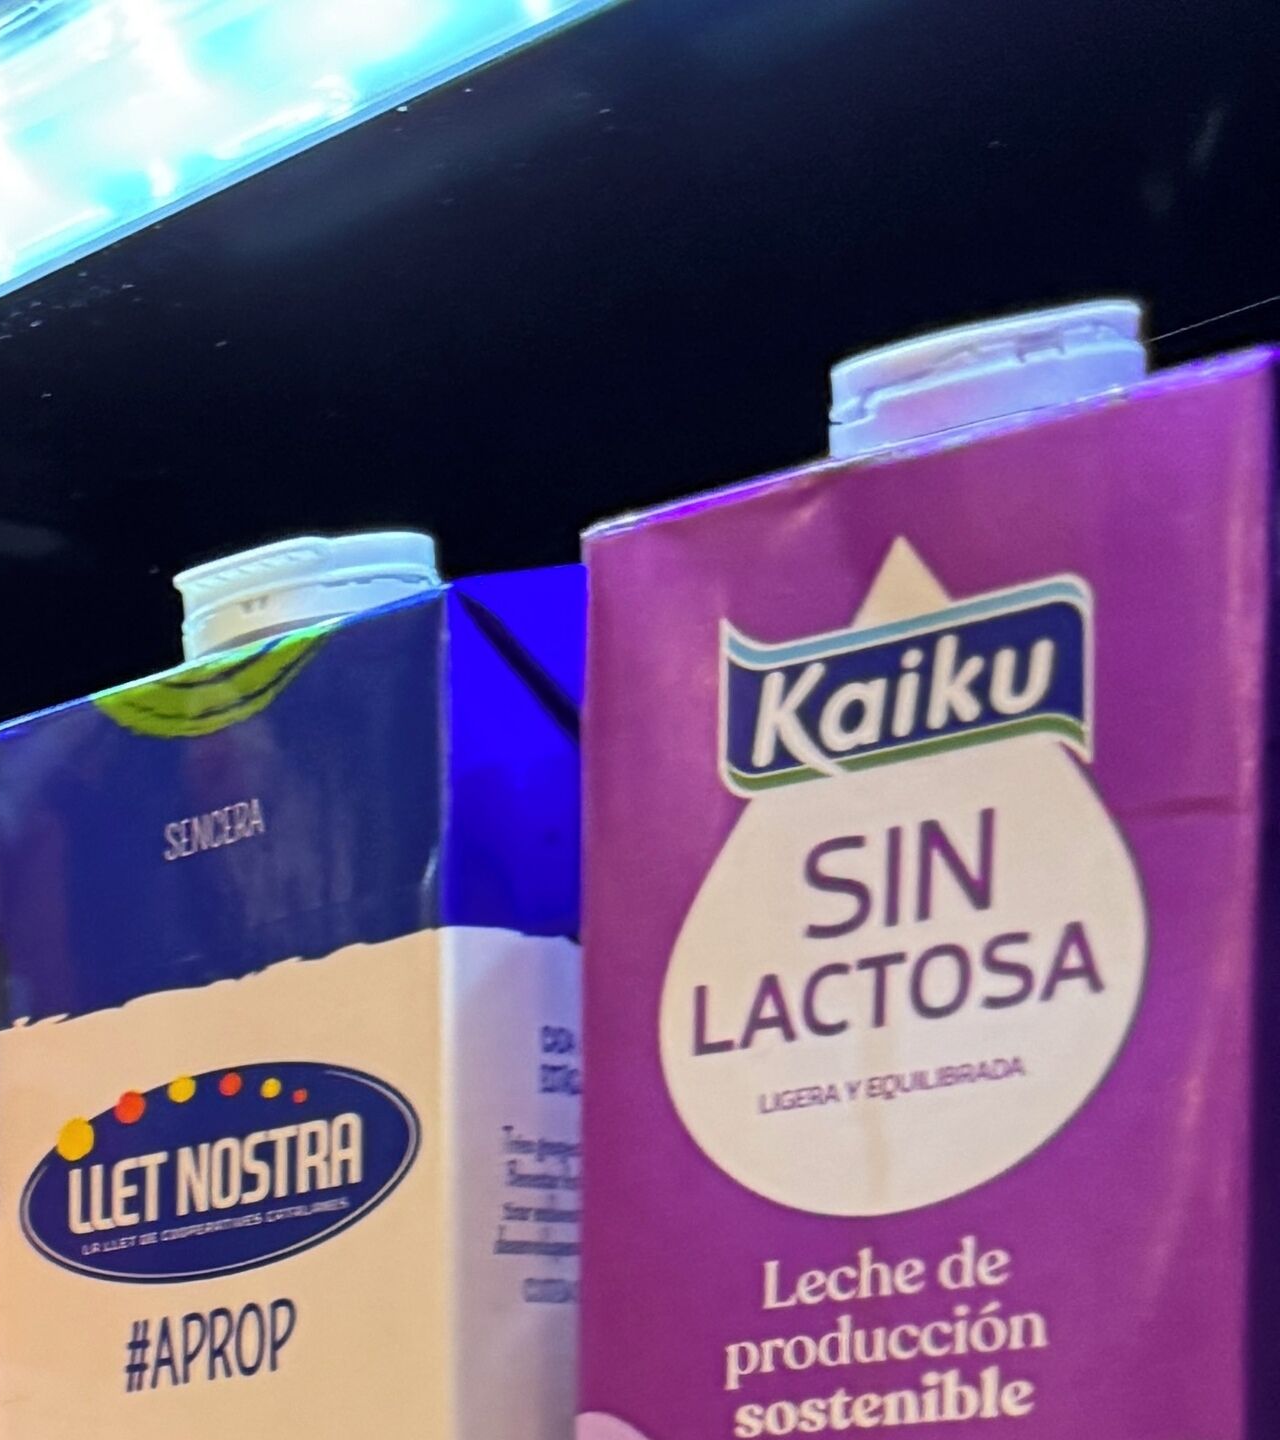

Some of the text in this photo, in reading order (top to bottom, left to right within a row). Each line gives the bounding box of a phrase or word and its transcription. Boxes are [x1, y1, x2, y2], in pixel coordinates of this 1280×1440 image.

[751, 634, 1056, 776] Kaiku
[163, 798, 266, 861] SENCERA
[802, 807, 996, 940] SIN
[690, 920, 1105, 1057] LACTOSA
[757, 1055, 1027, 1115] LIGERA Y EQUILIBRADA
[68, 1111, 364, 1235] LLET NOSTRA
[761, 1236, 1011, 1310] Leche de
[125, 1297, 297, 1392] #APROP
[723, 1303, 1048, 1390] producción
[733, 1368, 1036, 1438] sostenible
